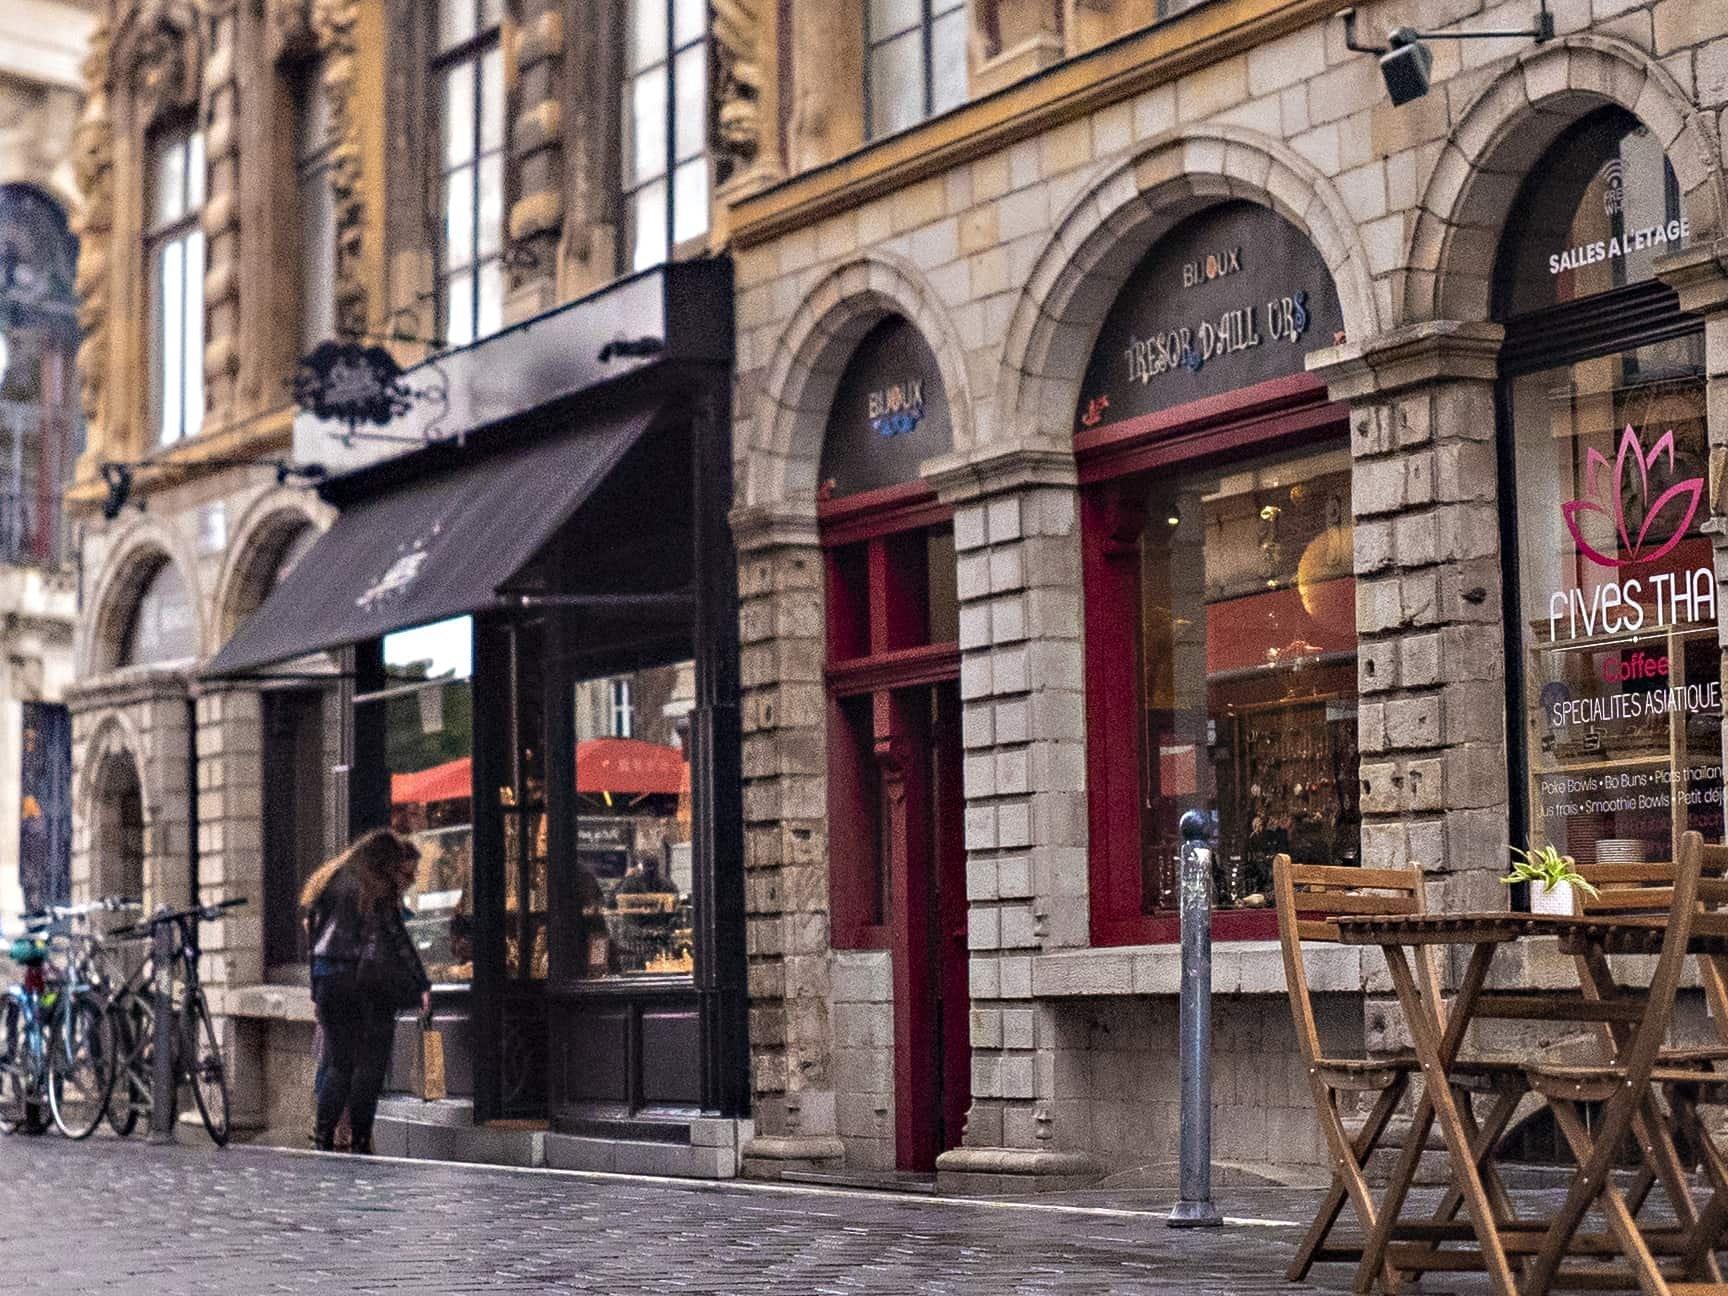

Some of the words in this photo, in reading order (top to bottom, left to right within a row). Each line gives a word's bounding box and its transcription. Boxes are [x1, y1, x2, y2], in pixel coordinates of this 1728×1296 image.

[1550, 241, 1605, 274] SALLES
[1608, 237, 1621, 258] A
[1623, 217, 1690, 253] L'ETAGE
[1184, 247, 1242, 288] BIJOUX
[1649, 568, 1716, 626] THA
[1603, 652, 1671, 683] Coffee
[1553, 692, 1642, 726] SPECIALITES
[1645, 681, 1723, 715] ASIATIQUE
[1541, 779, 1566, 795] Poke
[1567, 777, 1599, 793] Bowls
[1605, 775, 1620, 790] Bo
[1620, 772, 1648, 788] Buns
[1585, 795, 1637, 814] Smoothie
[1638, 793, 1670, 810] Bowls
